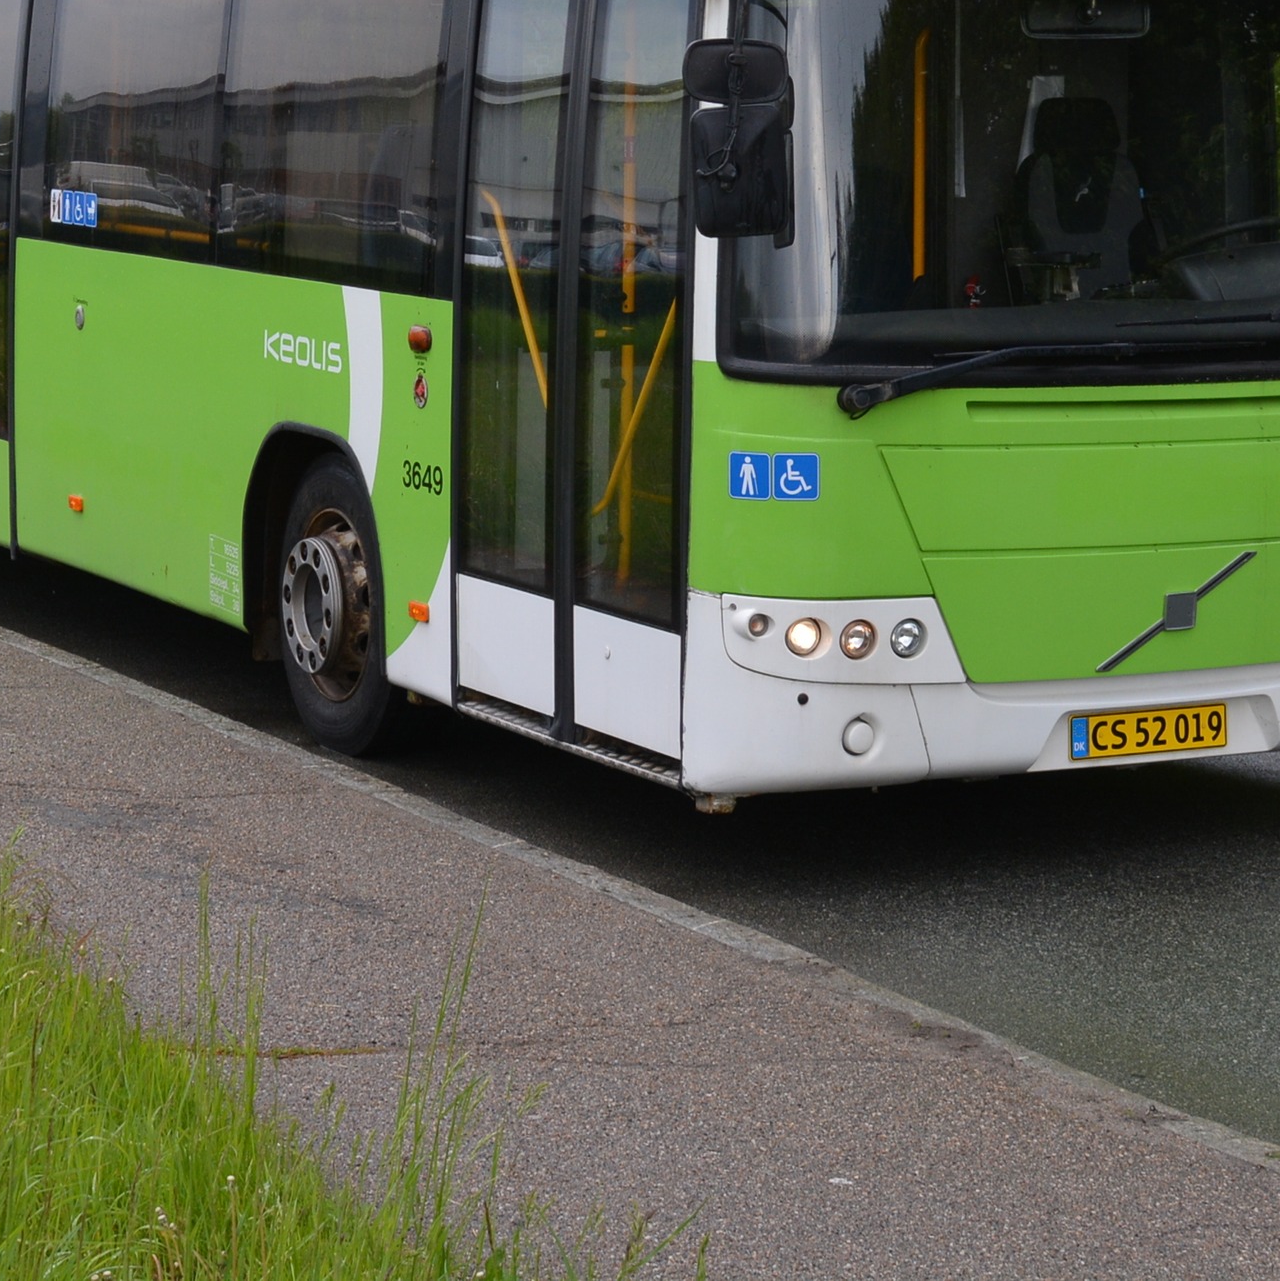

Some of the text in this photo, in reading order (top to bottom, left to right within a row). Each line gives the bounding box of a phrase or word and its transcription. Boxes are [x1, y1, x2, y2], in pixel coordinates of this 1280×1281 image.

[402, 459, 443, 496] 3649
[1073, 741, 1086, 752] DK
[1091, 710, 1223, 751] CS 52 019
